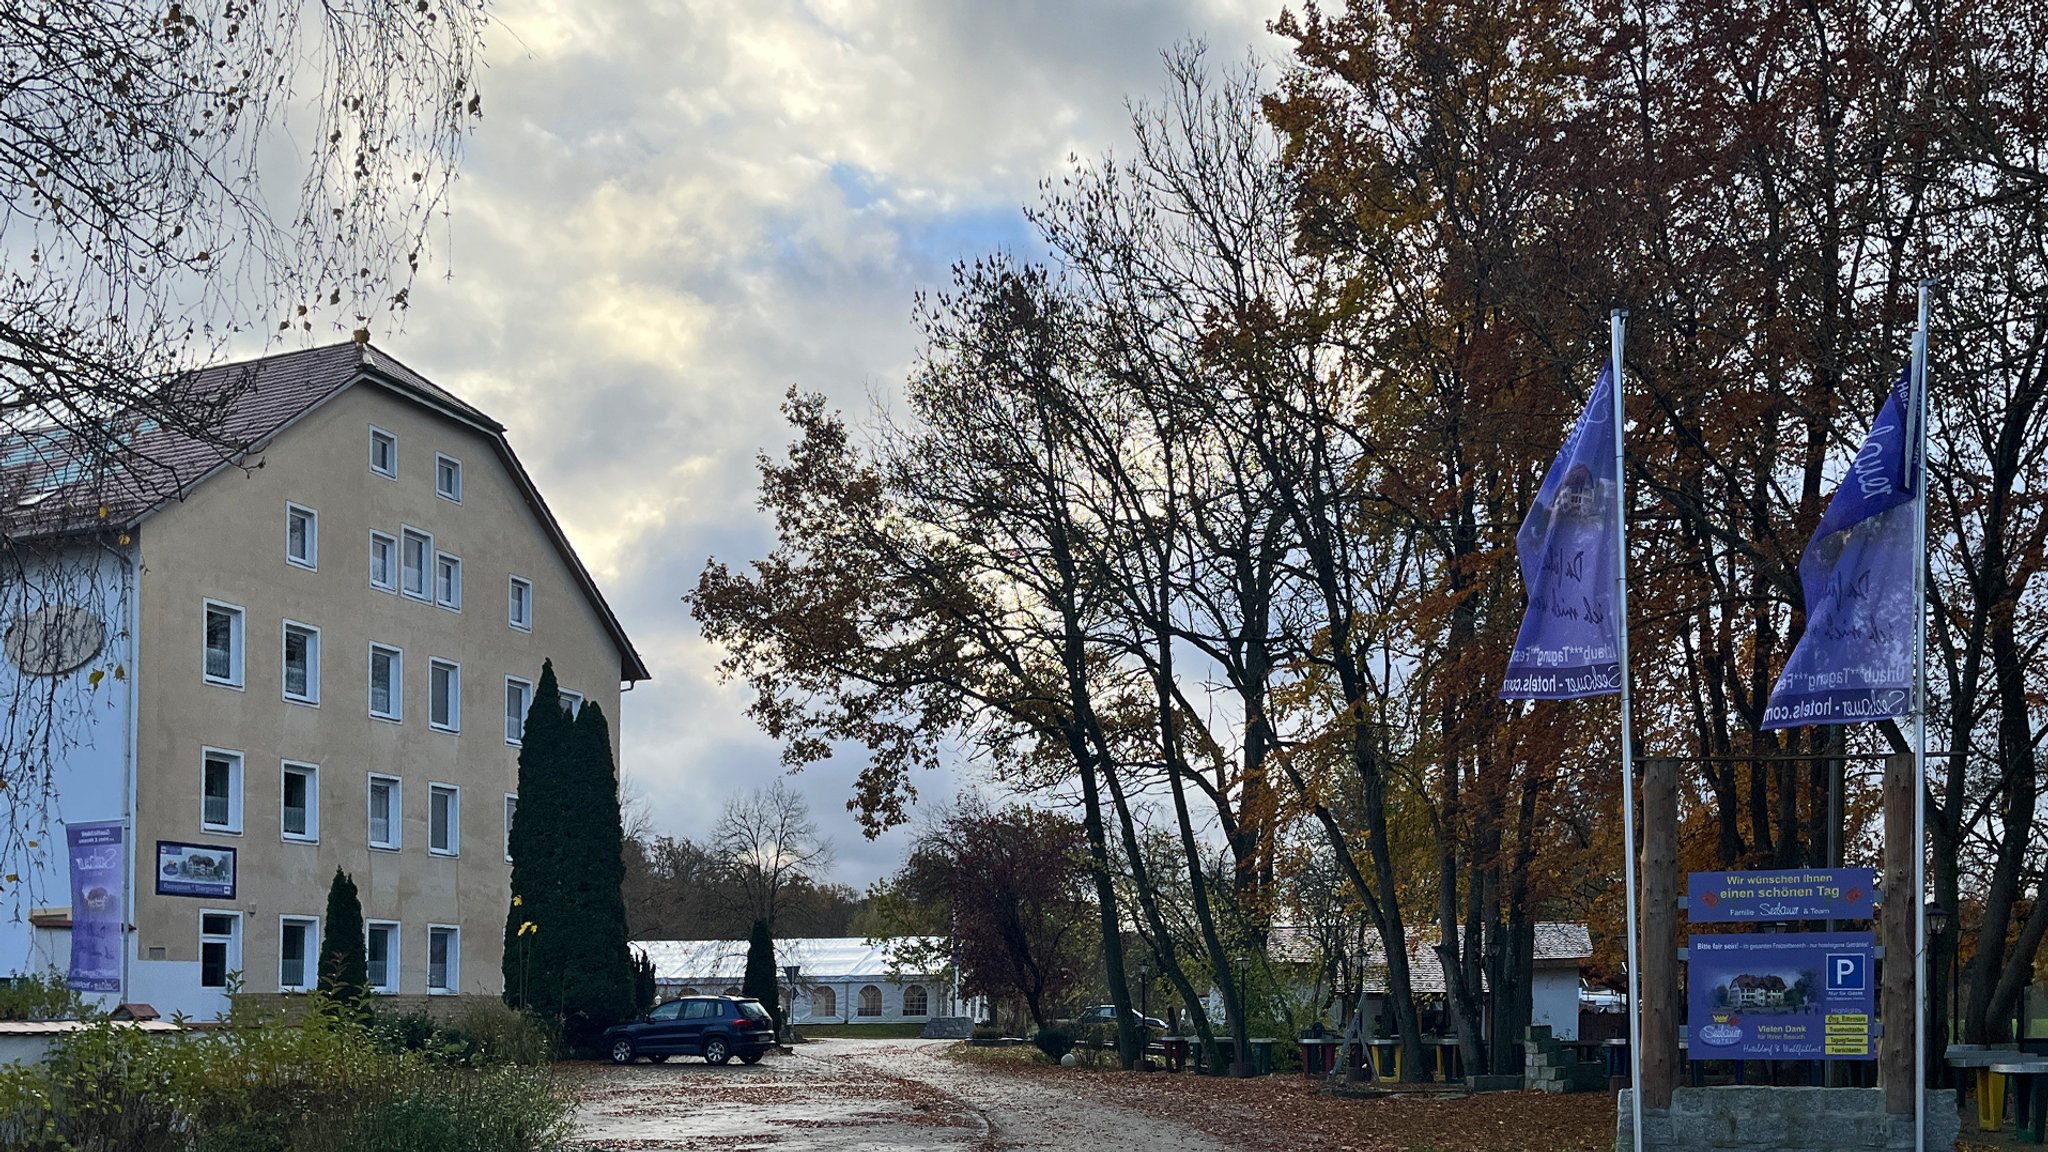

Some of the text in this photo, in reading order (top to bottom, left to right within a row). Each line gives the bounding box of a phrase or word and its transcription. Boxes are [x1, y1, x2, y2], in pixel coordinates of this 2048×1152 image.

[1727, 874, 1833, 885] Wir wünschen Ihnen
[1720, 886, 1840, 899] einen schönen Tag
[1837, 959, 1854, 985] P
[1758, 1025, 1806, 1033] Vielen Dank
